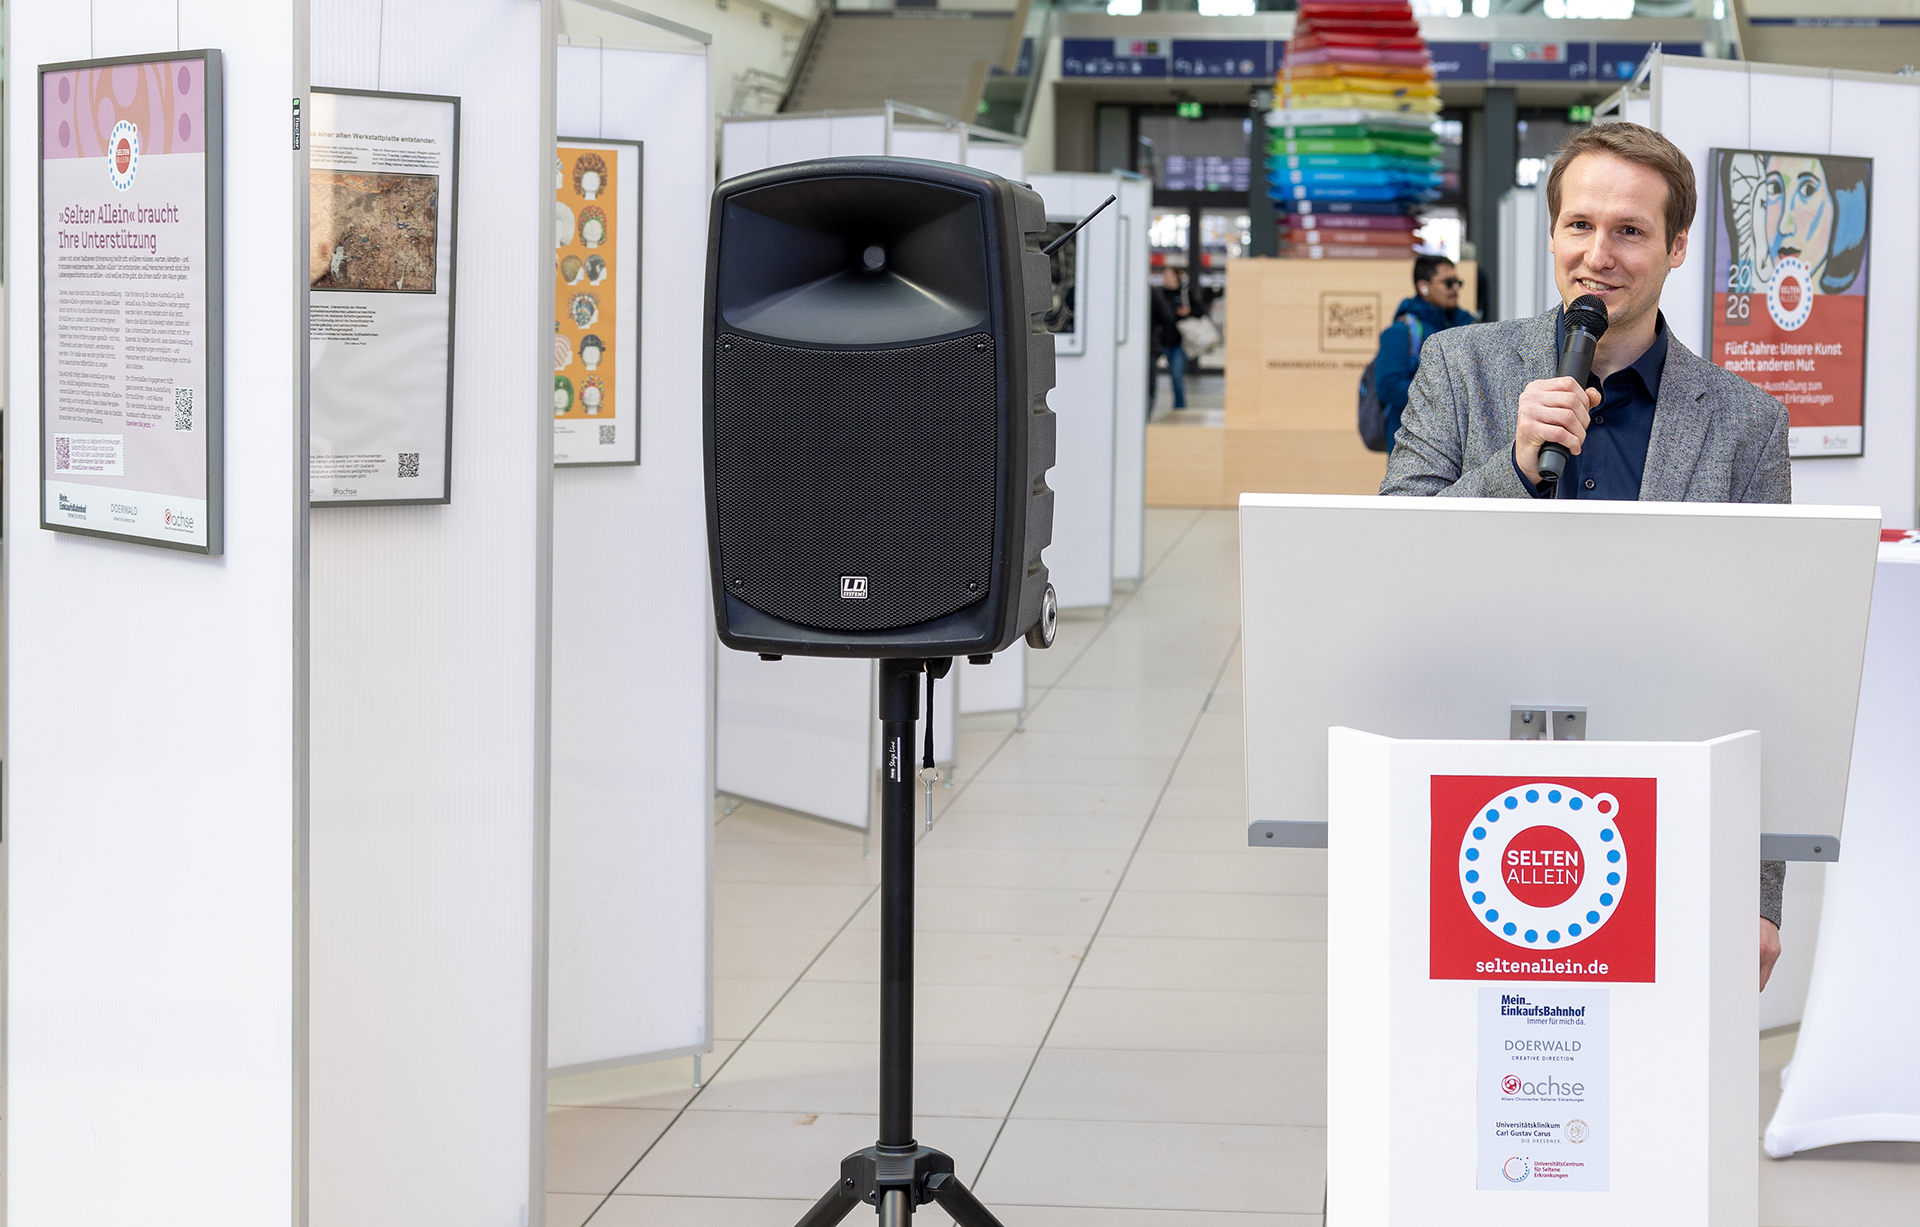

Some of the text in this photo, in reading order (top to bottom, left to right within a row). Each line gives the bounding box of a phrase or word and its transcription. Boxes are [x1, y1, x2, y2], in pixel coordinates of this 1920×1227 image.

[352, 133, 400, 142] Werkstattplatte
[400, 135, 436, 144] entstanden.
[59, 202, 179, 224] »Selten Allein« braucht
[58, 229, 156, 254] Ihre Unterstützung
[1728, 264, 1751, 288] 20
[1726, 295, 1750, 319] 26
[1725, 341, 1842, 356] Fünf Jahre: Unsere Kunst
[1725, 358, 1815, 372] macht anderen Mut
[1785, 394, 1833, 406] Erkrankungen
[110, 503, 138, 516] DOERWALD
[171, 511, 194, 528] achse
[844, 579, 865, 591] LD
[1507, 850, 1578, 866] SELTEN
[1507, 869, 1578, 884] ALLEIN
[1476, 958, 1608, 974] seltenallein.de
[1501, 994, 1531, 1005] Mein_
[1501, 1006, 1586, 1017] EinkaufsBahnhof
[1505, 1040, 1581, 1052] DOERWALD
[1522, 1075, 1584, 1096] achse
